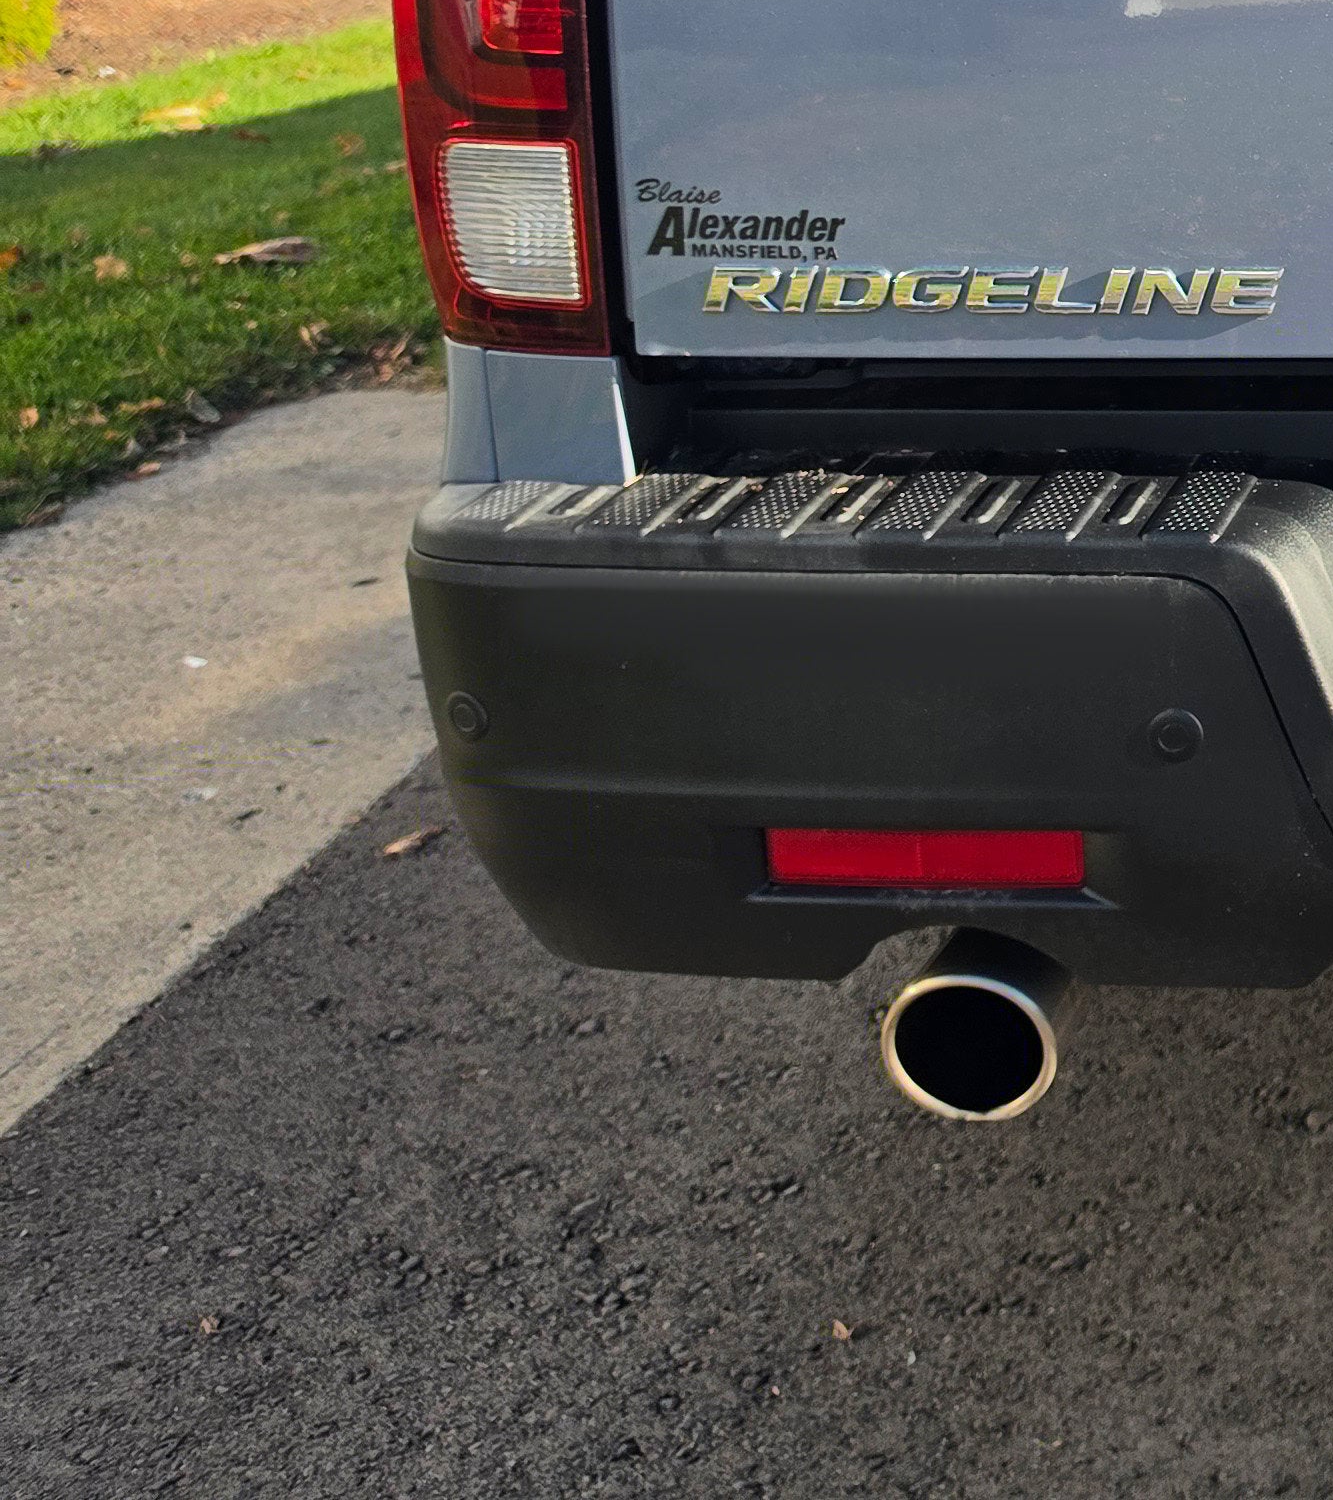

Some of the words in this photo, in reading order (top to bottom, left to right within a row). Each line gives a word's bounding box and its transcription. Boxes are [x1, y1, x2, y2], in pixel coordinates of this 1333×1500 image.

[635, 178, 722, 204] Blaise
[646, 205, 846, 256] Alexander
[691, 243, 808, 263] MANSFIELD,
[813, 246, 839, 261] PA
[701, 264, 1286, 315] RIDGELINE
